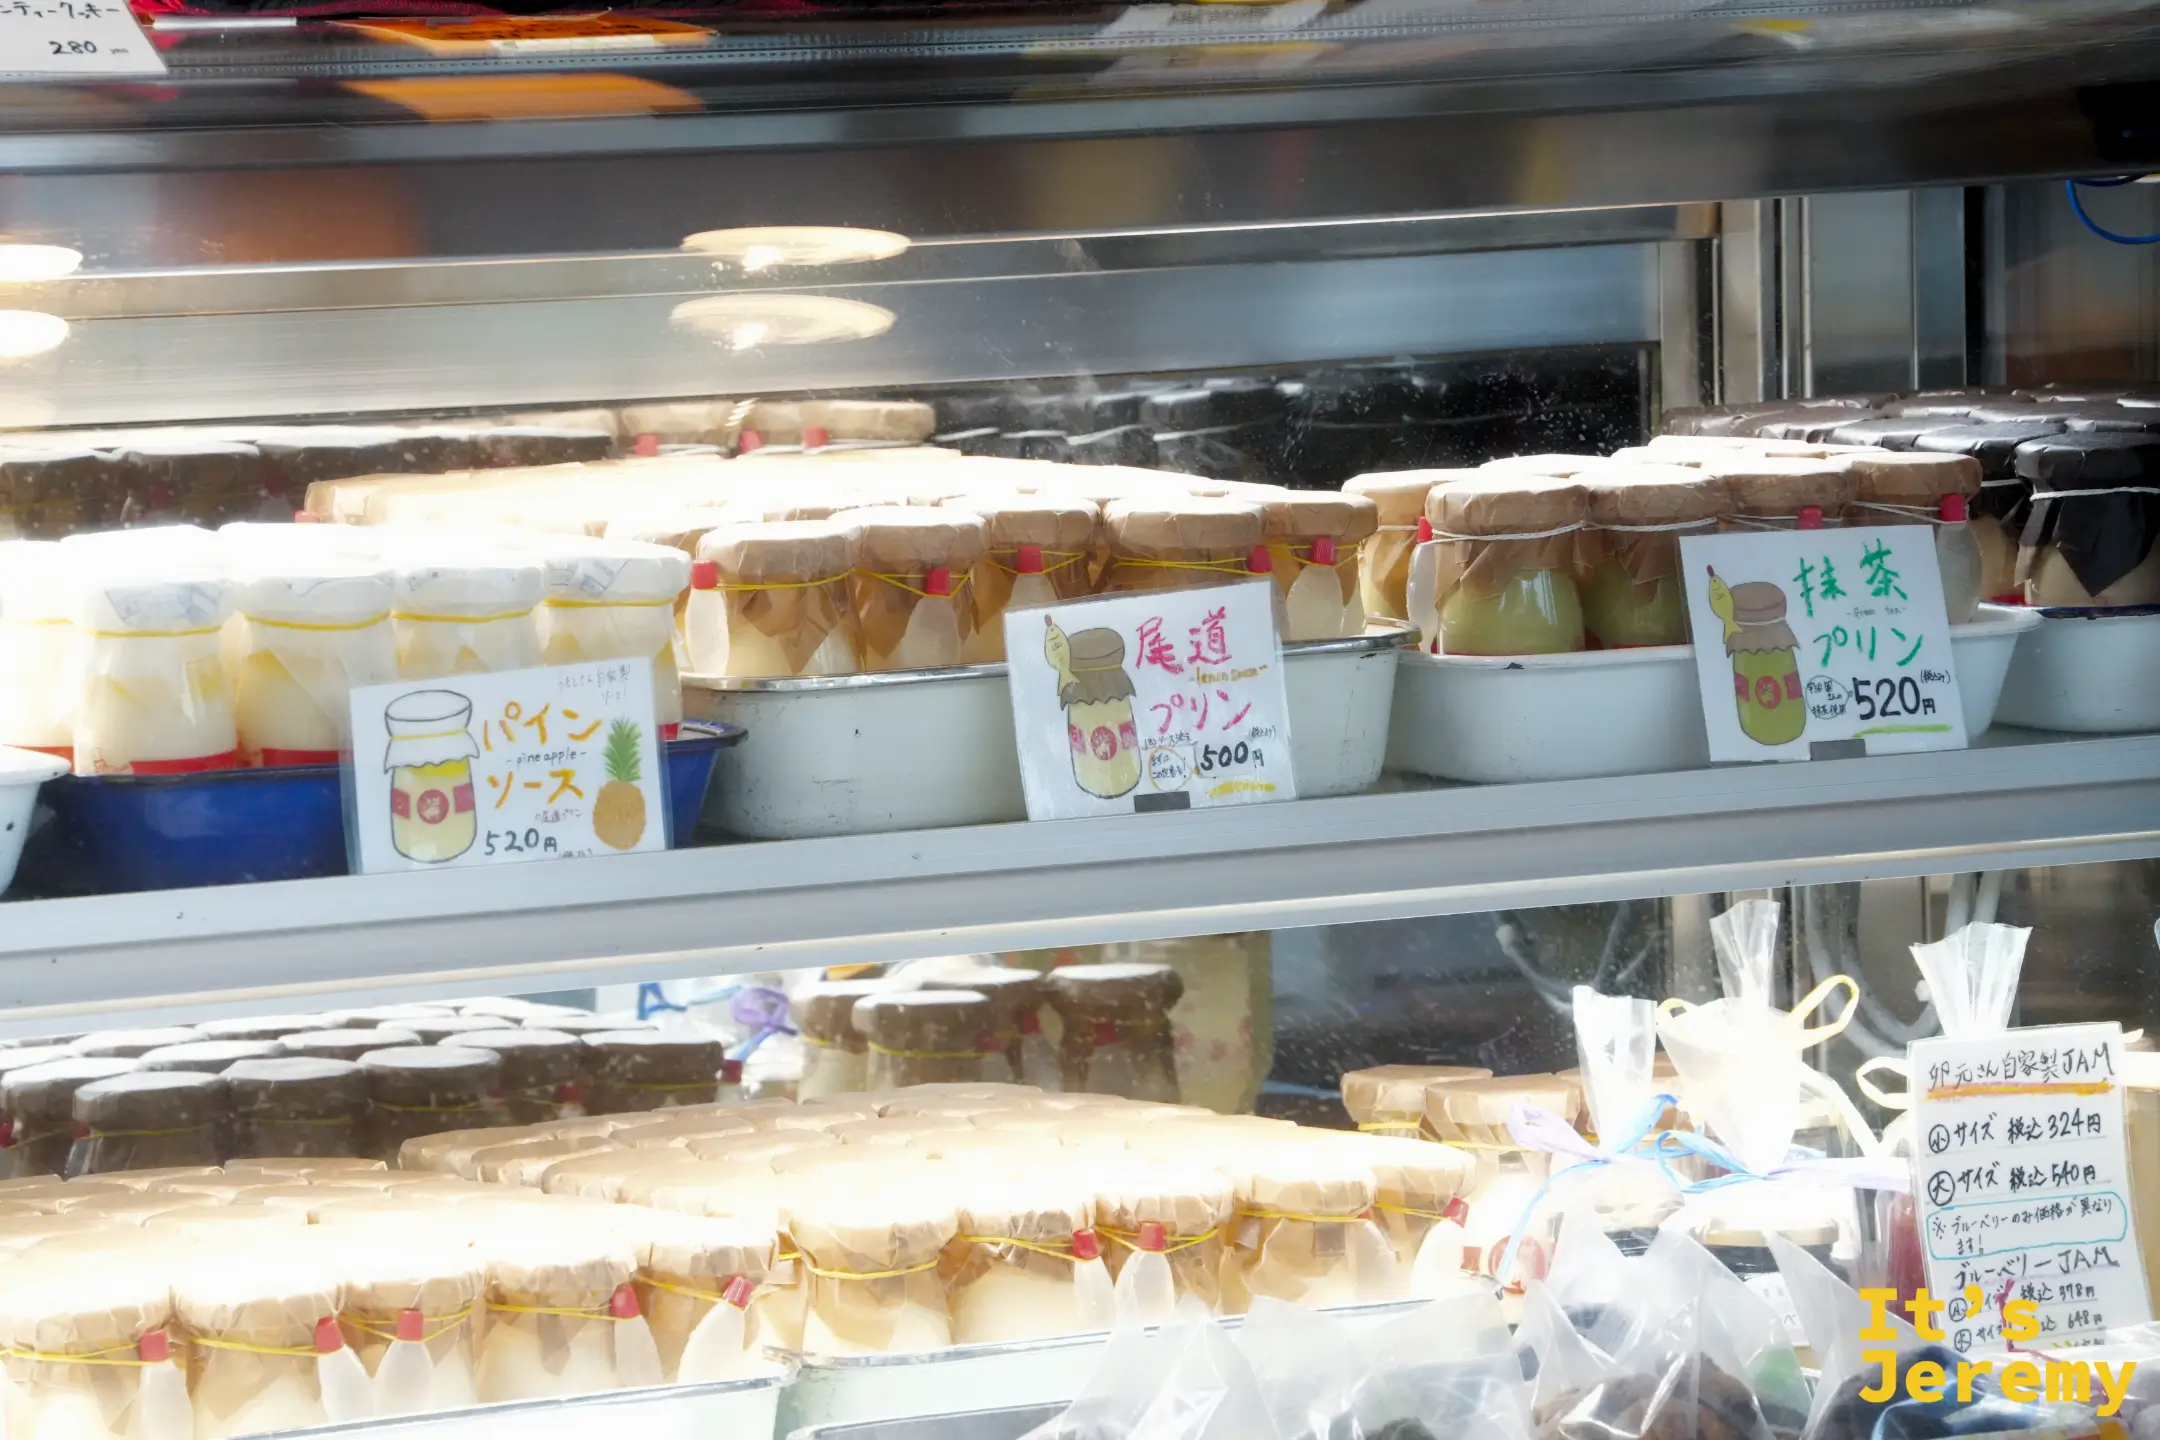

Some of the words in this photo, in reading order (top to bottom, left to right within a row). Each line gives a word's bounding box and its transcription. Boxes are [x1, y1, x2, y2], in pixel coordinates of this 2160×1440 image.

[49, 40, 98, 55] 280
[1793, 538, 1908, 618] 抹茶
[1136, 605, 1233, 675] 尾道
[1813, 625, 1924, 667] プリン
[1150, 689, 1252, 735] プリン
[1852, 676, 1936, 720] 520円
[483, 700, 602, 752] パイン
[1200, 740, 1265, 771] 500円
[487, 768, 584, 809] ソース
[484, 827, 558, 856] 520円
